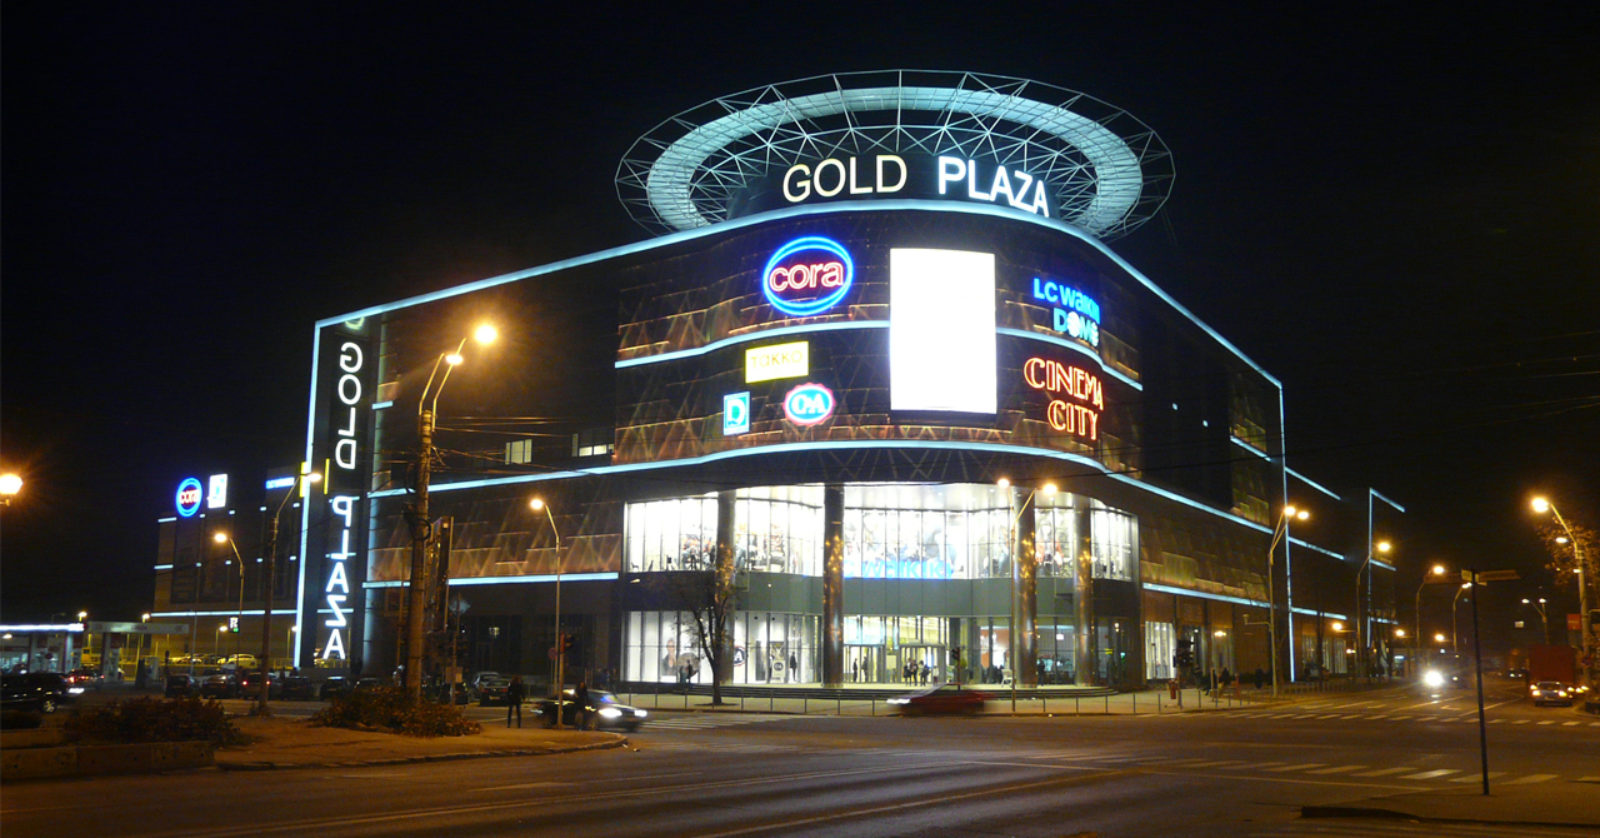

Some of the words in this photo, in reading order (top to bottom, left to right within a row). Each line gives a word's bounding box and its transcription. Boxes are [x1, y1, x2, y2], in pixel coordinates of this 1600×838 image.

[783, 155, 907, 203] GOLD
[938, 156, 1050, 217] PLAZA
[769, 262, 844, 292] cora
[1033, 278, 1059, 303] LC
[1024, 357, 1104, 410] CINEMA
[1047, 399, 1098, 440] CITY
